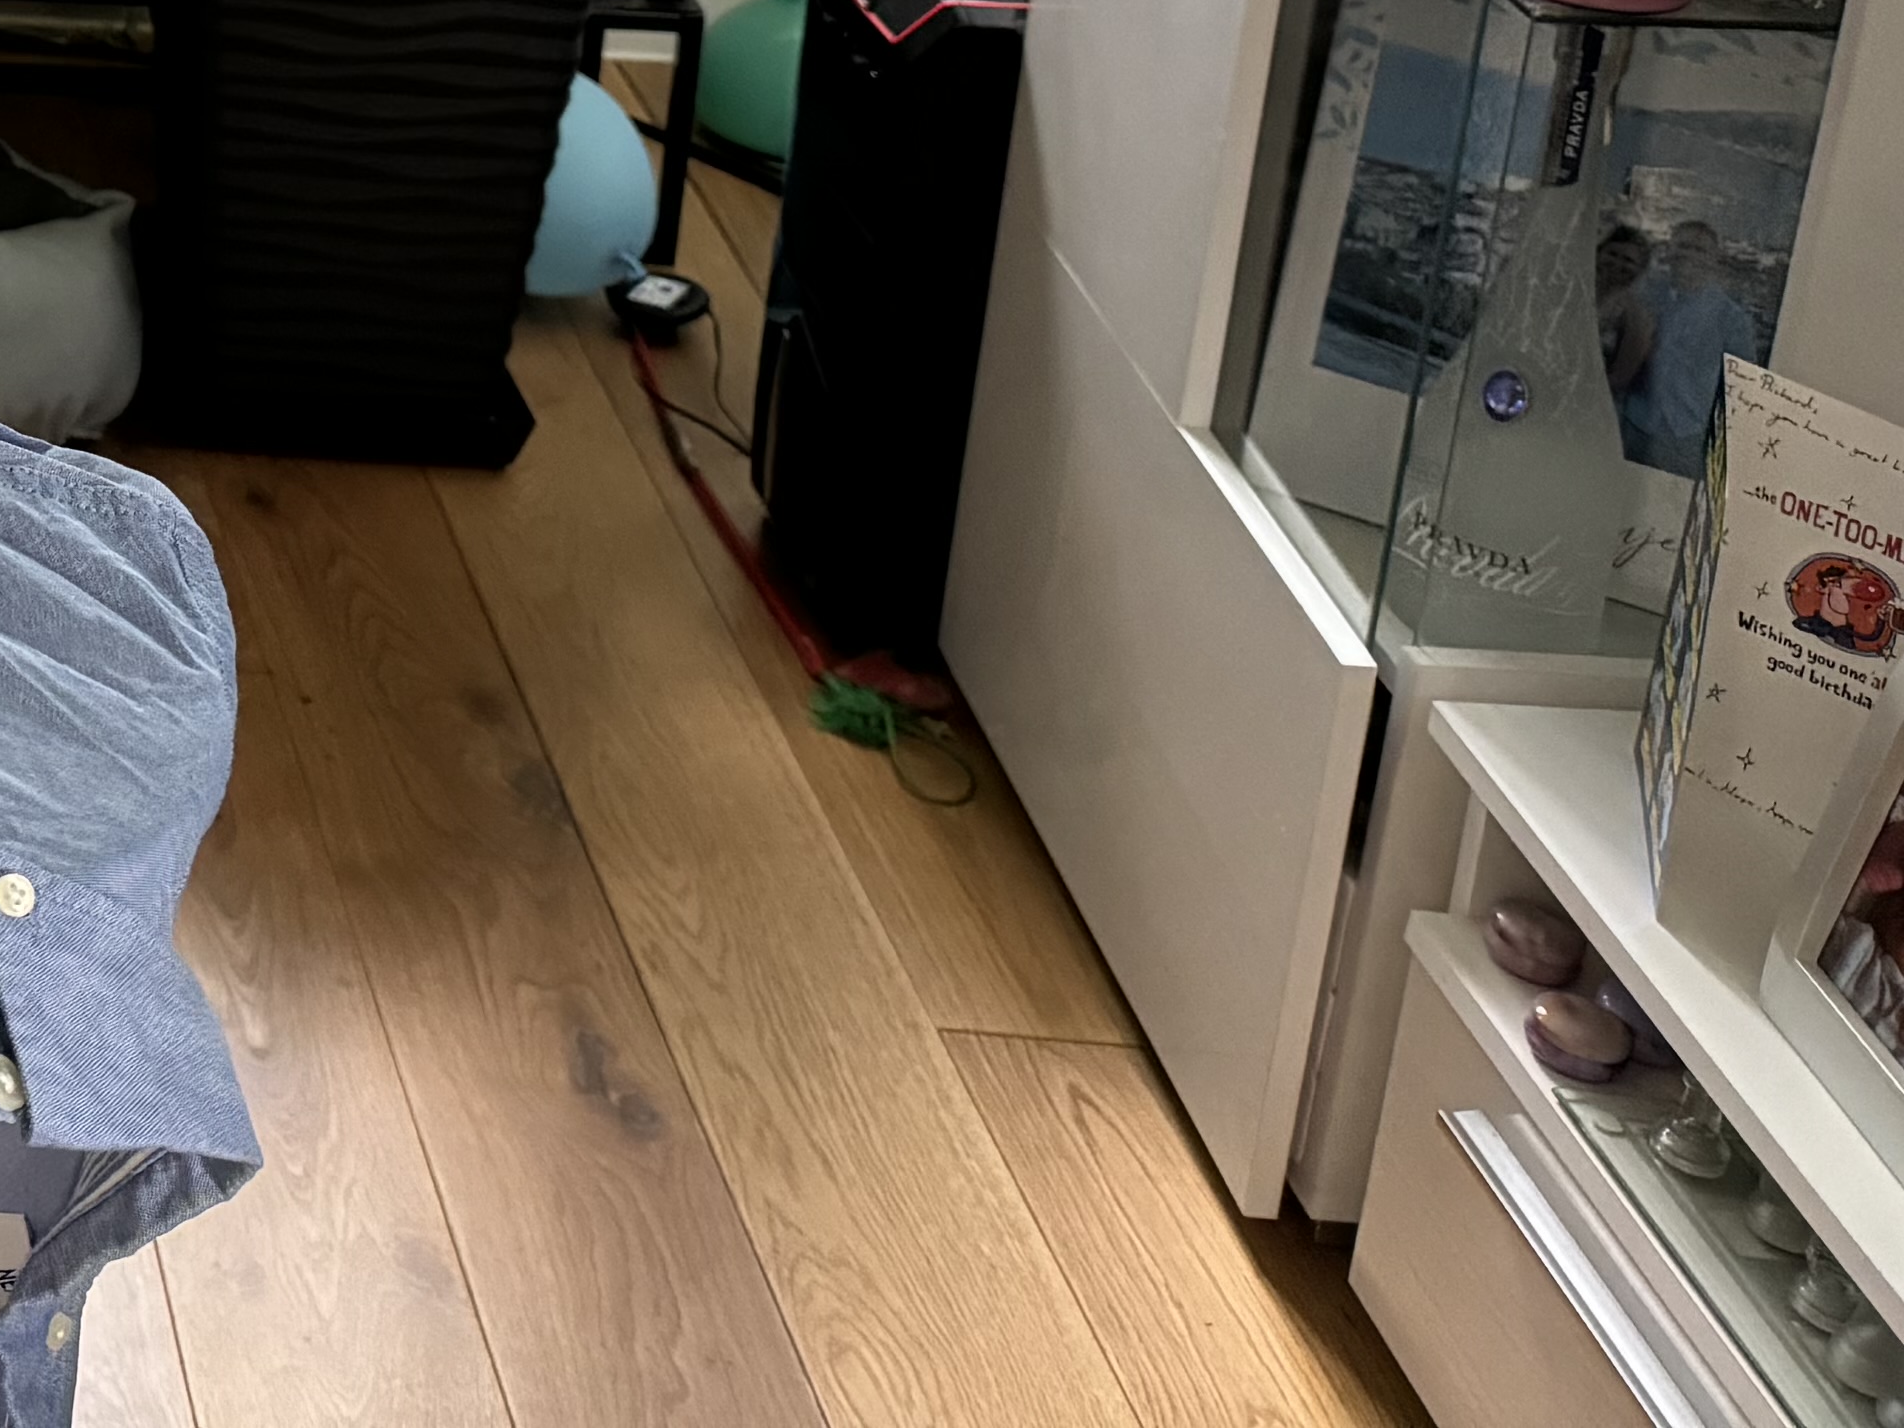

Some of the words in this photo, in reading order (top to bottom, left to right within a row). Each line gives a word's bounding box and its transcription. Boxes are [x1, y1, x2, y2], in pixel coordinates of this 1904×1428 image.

[1564, 90, 1589, 159] PRAVDA
[1780, 491, 1904, 565] ONE-TOO-M
[1738, 610, 1802, 658] Wishing
[1808, 649, 1836, 669] you
[1839, 663, 1868, 685] one
[1767, 656, 1806, 679] good
[1809, 669, 1874, 711] birthda
